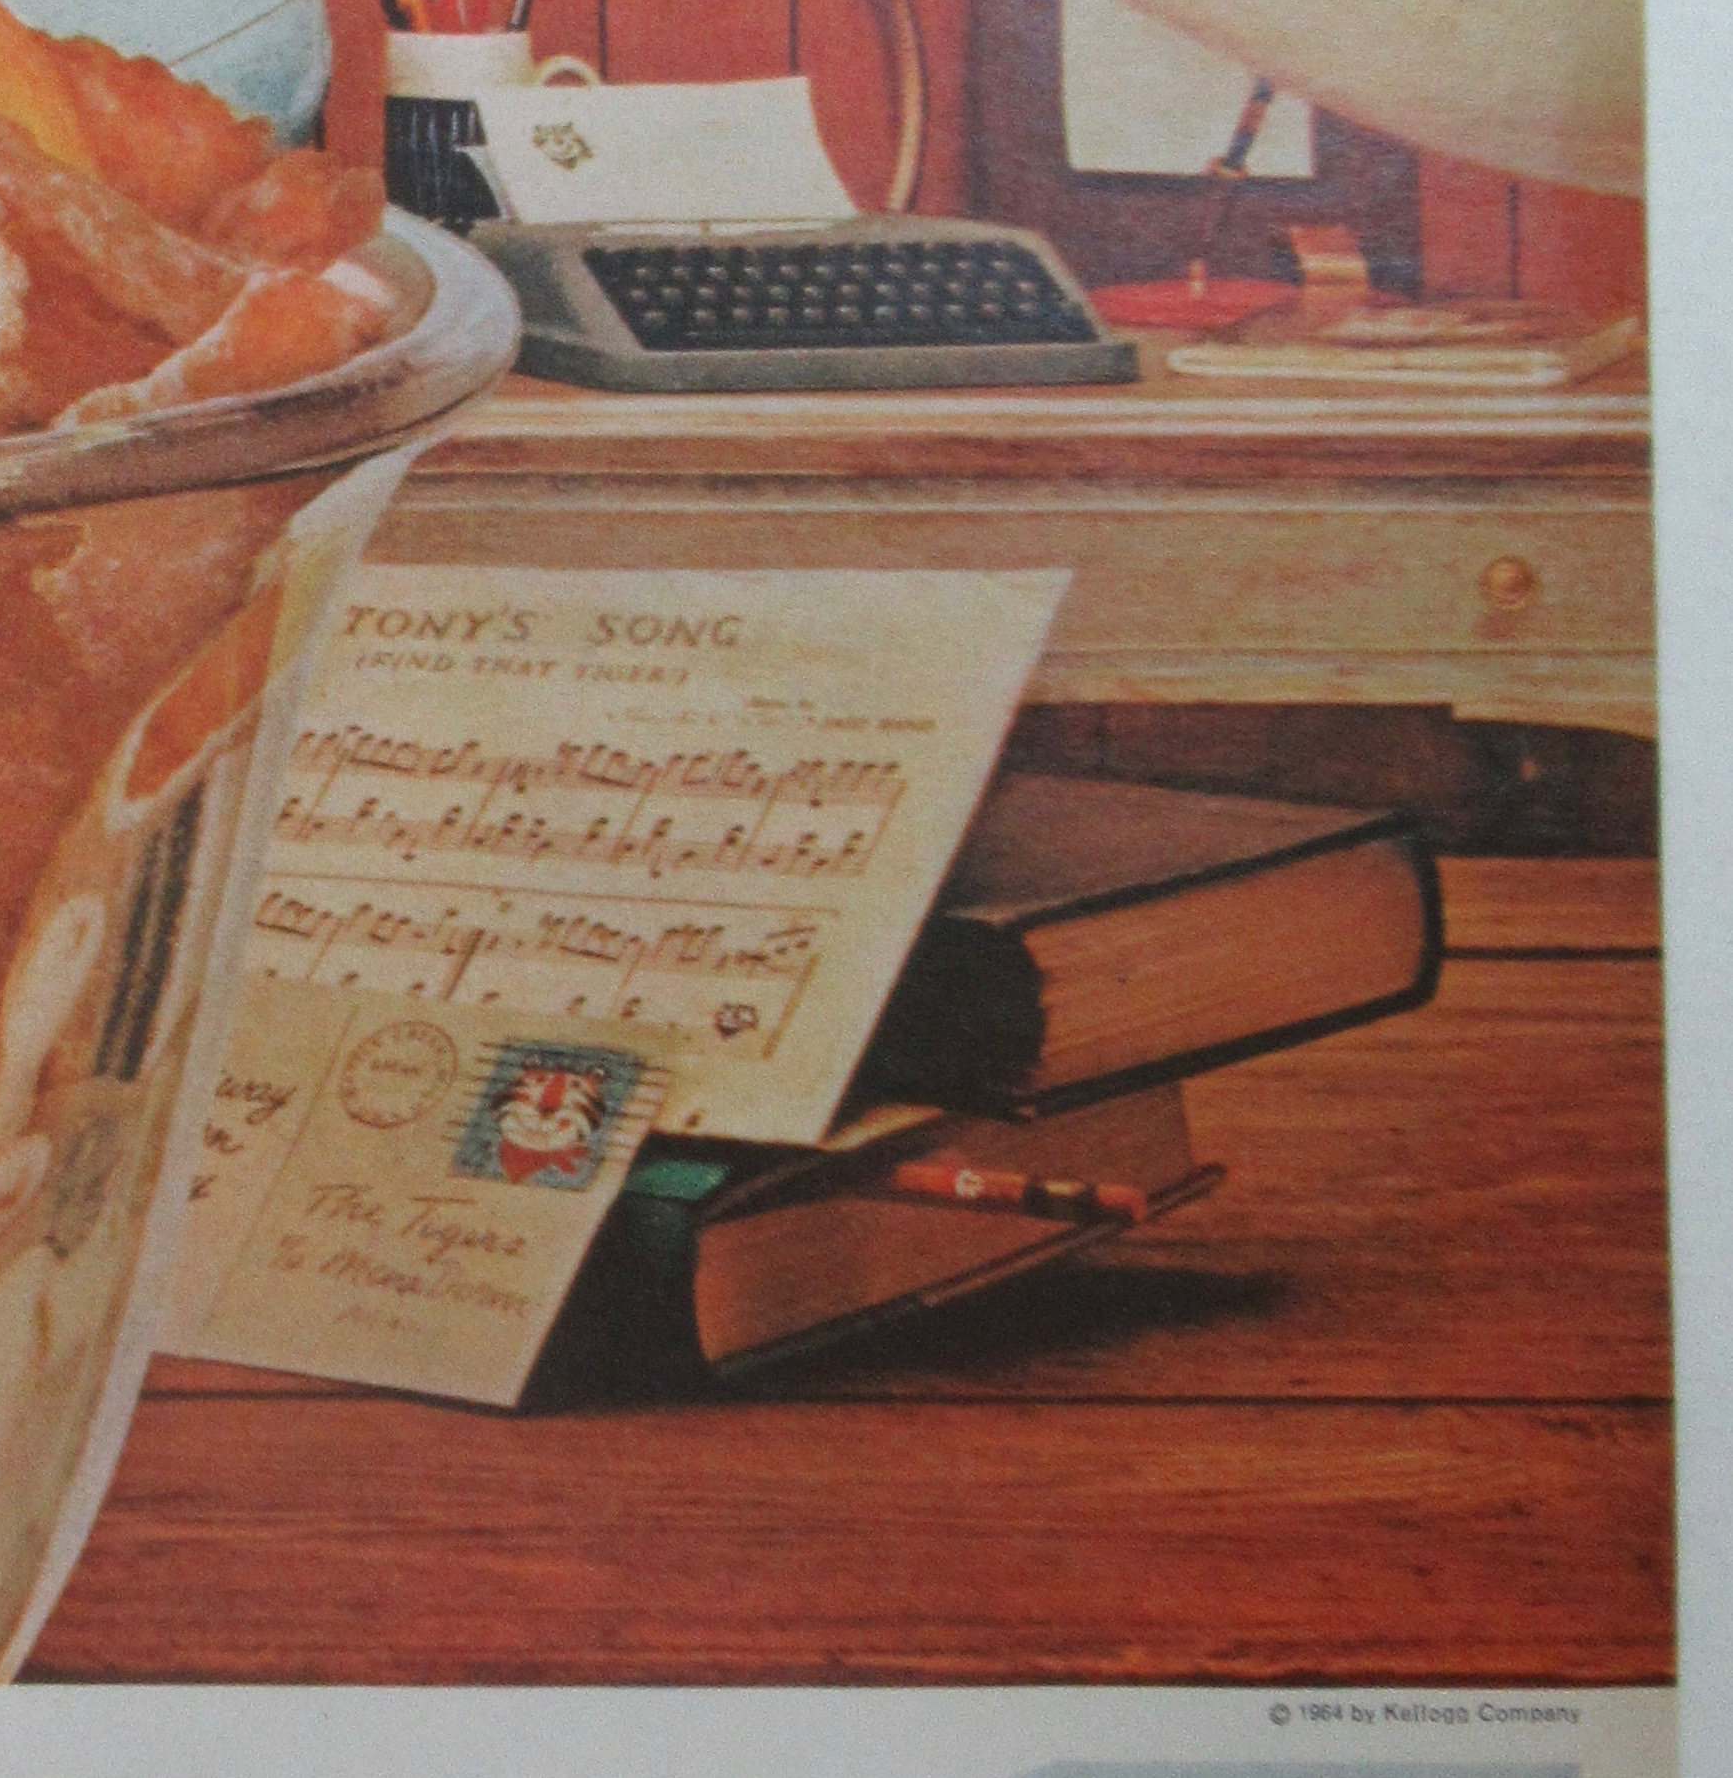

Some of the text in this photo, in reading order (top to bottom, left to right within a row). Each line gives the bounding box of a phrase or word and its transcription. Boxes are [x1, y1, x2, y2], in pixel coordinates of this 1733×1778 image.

[343, 601, 746, 649] TONY'S SONG
[1349, 1702, 1377, 1724] by
[1382, 1702, 1470, 1725] Kellogg
[1476, 1701, 1583, 1725] Company
